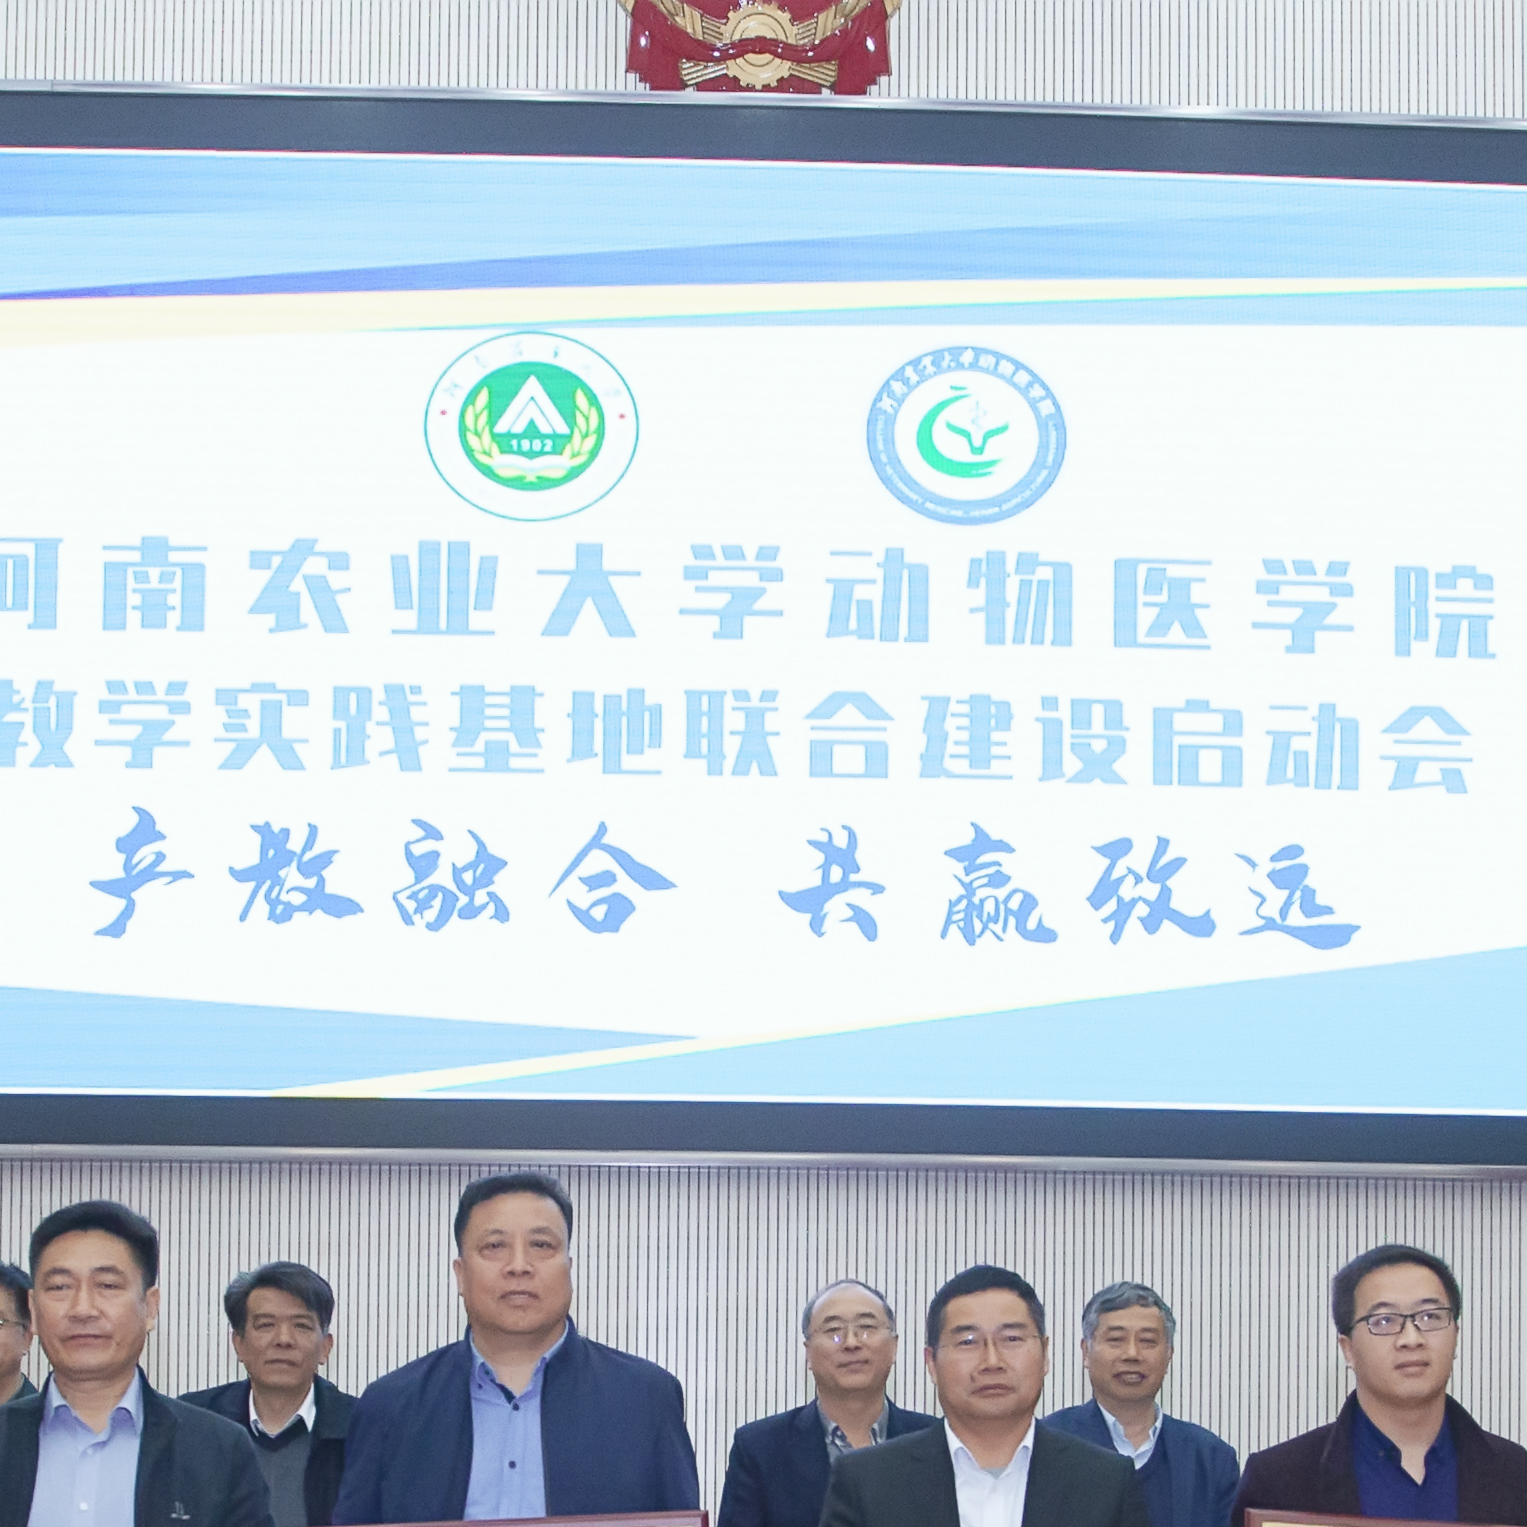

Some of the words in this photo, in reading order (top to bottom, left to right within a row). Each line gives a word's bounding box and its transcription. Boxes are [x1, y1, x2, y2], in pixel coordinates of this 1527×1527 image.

[510, 438, 554, 452] 1902
[89, 805, 678, 940] 产教融合
[777, 821, 1364, 952] 共赢致远
